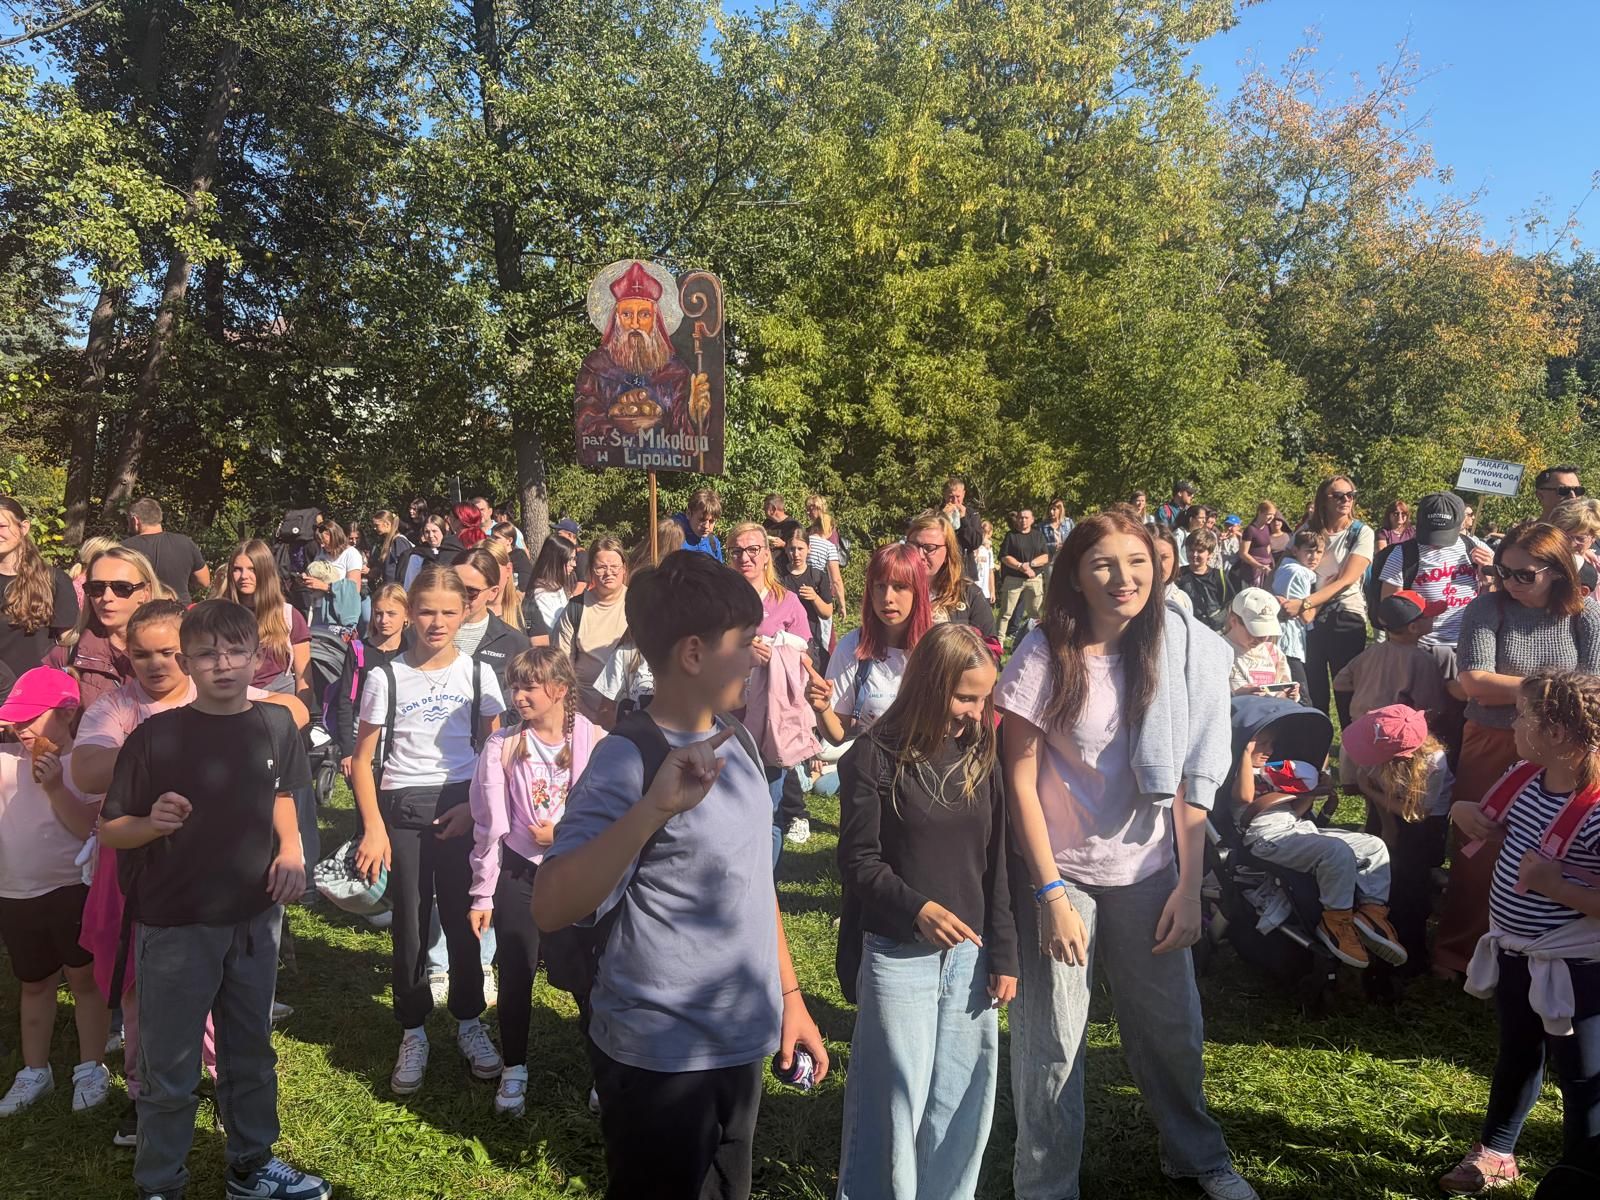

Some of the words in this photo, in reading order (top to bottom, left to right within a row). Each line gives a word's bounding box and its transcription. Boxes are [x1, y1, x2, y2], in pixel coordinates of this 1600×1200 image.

[582, 434, 607, 449] par.
[638, 427, 709, 456] Mikołaja
[624, 447, 692, 469] Lipowcu
[1476, 460, 1509, 471] PARAFIA
[1461, 467, 1519, 482] KRZYNOWŁOGA
[1473, 477, 1502, 488] WIELKA
[421, 696, 433, 705] DE
